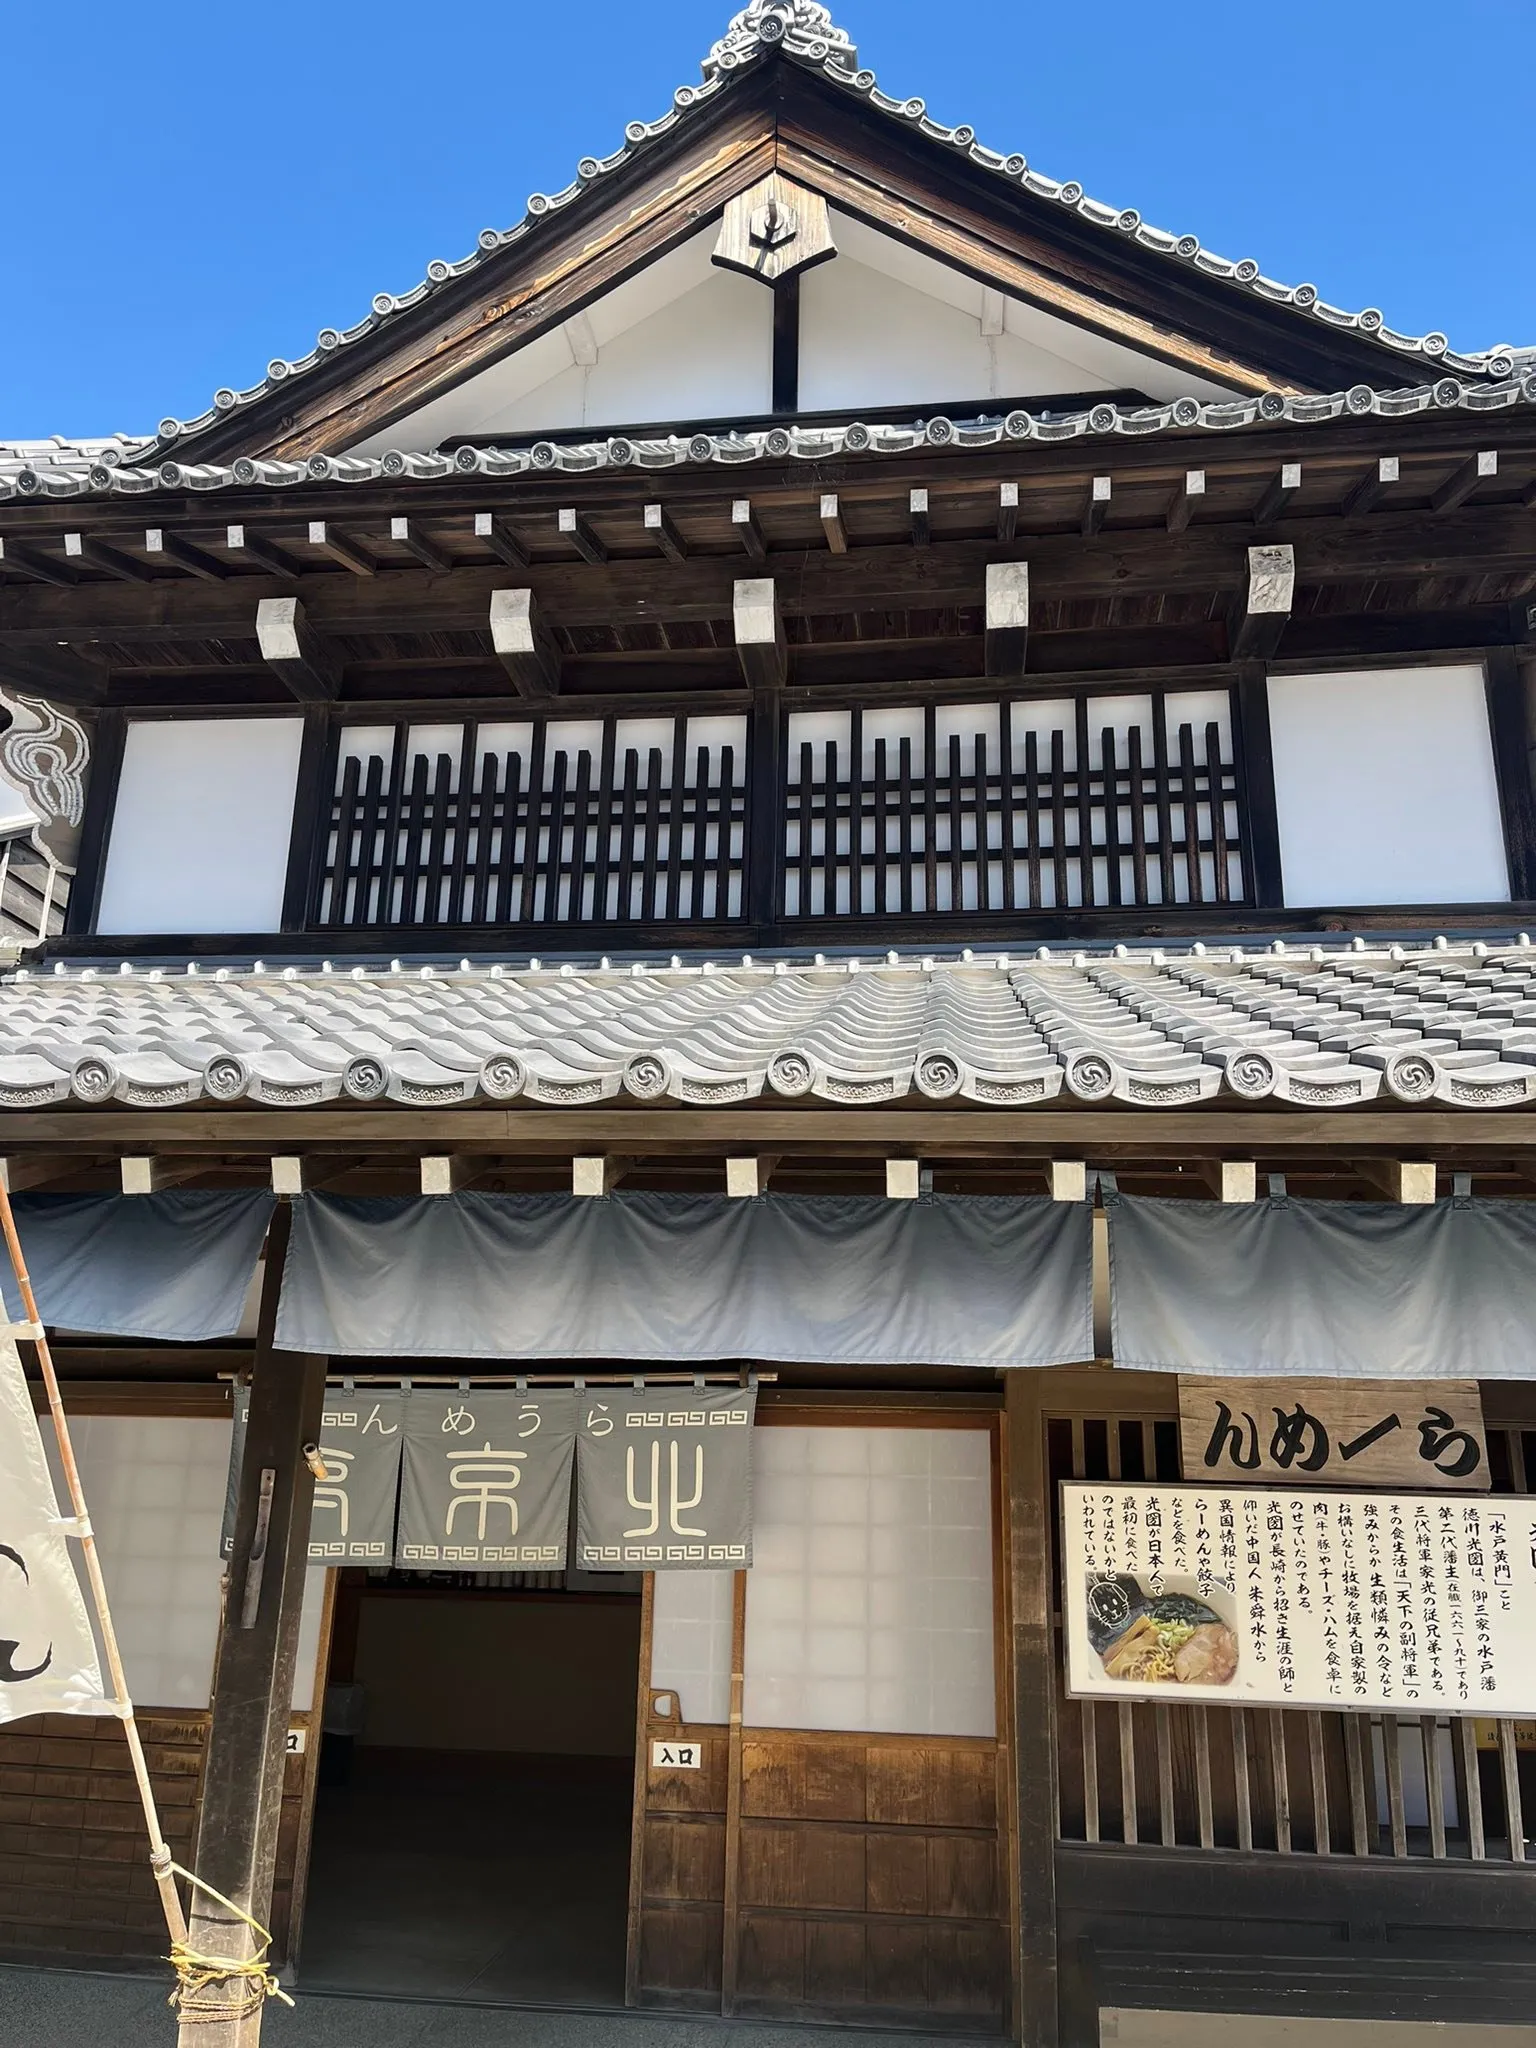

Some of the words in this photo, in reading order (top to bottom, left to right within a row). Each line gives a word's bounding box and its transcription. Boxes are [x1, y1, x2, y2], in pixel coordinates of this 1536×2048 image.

[1204, 1399, 1481, 1477] らーめん
[1083, 1494, 1098, 1570] いわれている。
[1102, 1494, 1117, 1581] のではないかと
[1121, 1496, 1138, 1572] 最初に食べた
[1171, 1497, 1189, 1573] などを食べた。
[1194, 1498, 1214, 1598] らーめんや餃子
[1218, 1499, 1237, 1594] 異国情報により
[1289, 1501, 1313, 1614] のせていたのである。
[661, 1747, 694, 1765] 入口
